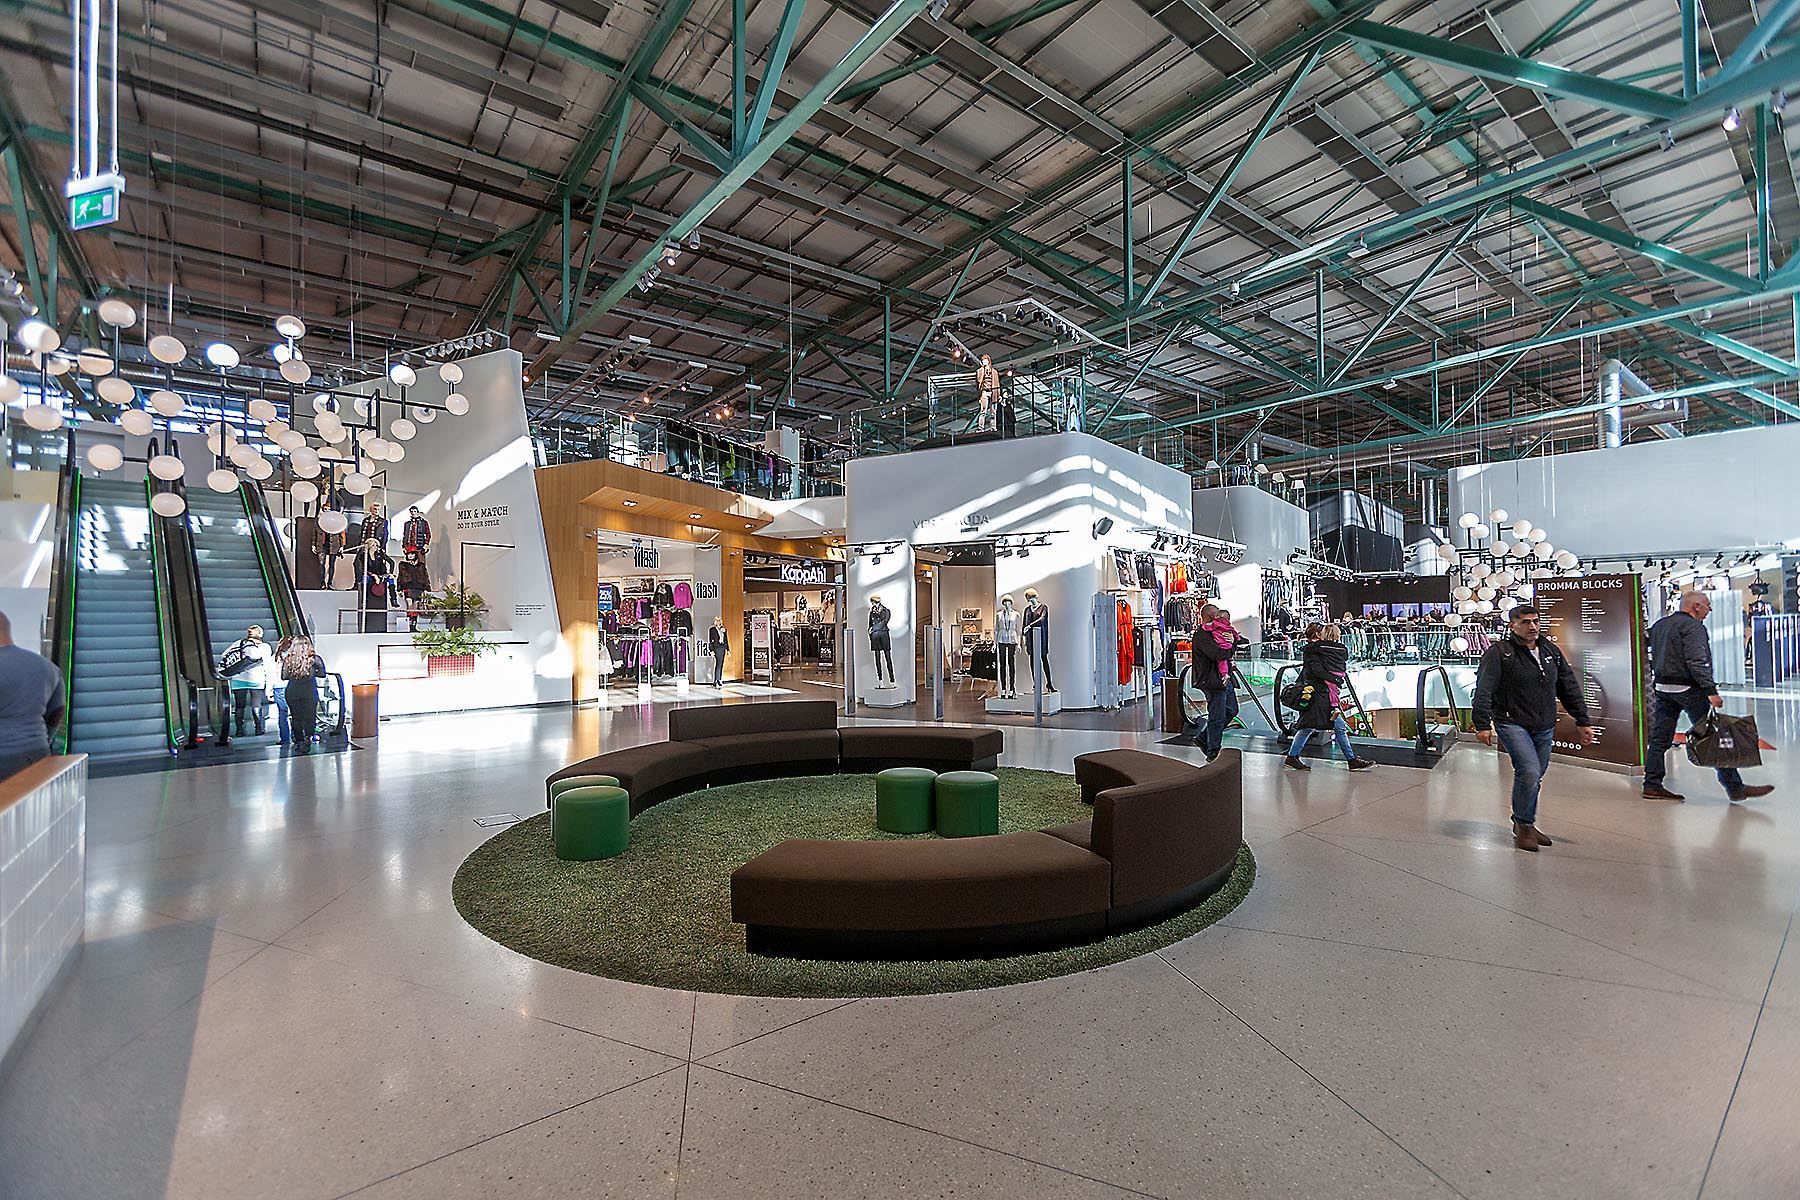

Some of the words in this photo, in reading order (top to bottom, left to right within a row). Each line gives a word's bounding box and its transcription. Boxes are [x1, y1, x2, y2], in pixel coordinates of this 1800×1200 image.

[457, 507, 472, 520] MIX
[473, 508, 480, 519] &
[480, 505, 509, 518] MATCH
[457, 522, 464, 530] DO
[471, 520, 484, 528] YOUR
[484, 519, 500, 527] STYLE
[781, 563, 827, 586] KappAhl
[696, 582, 718, 599] flash
[1537, 582, 1580, 591] BROMMA
[1581, 579, 1623, 590] BLOCKS
[754, 651, 768, 660] 25%
